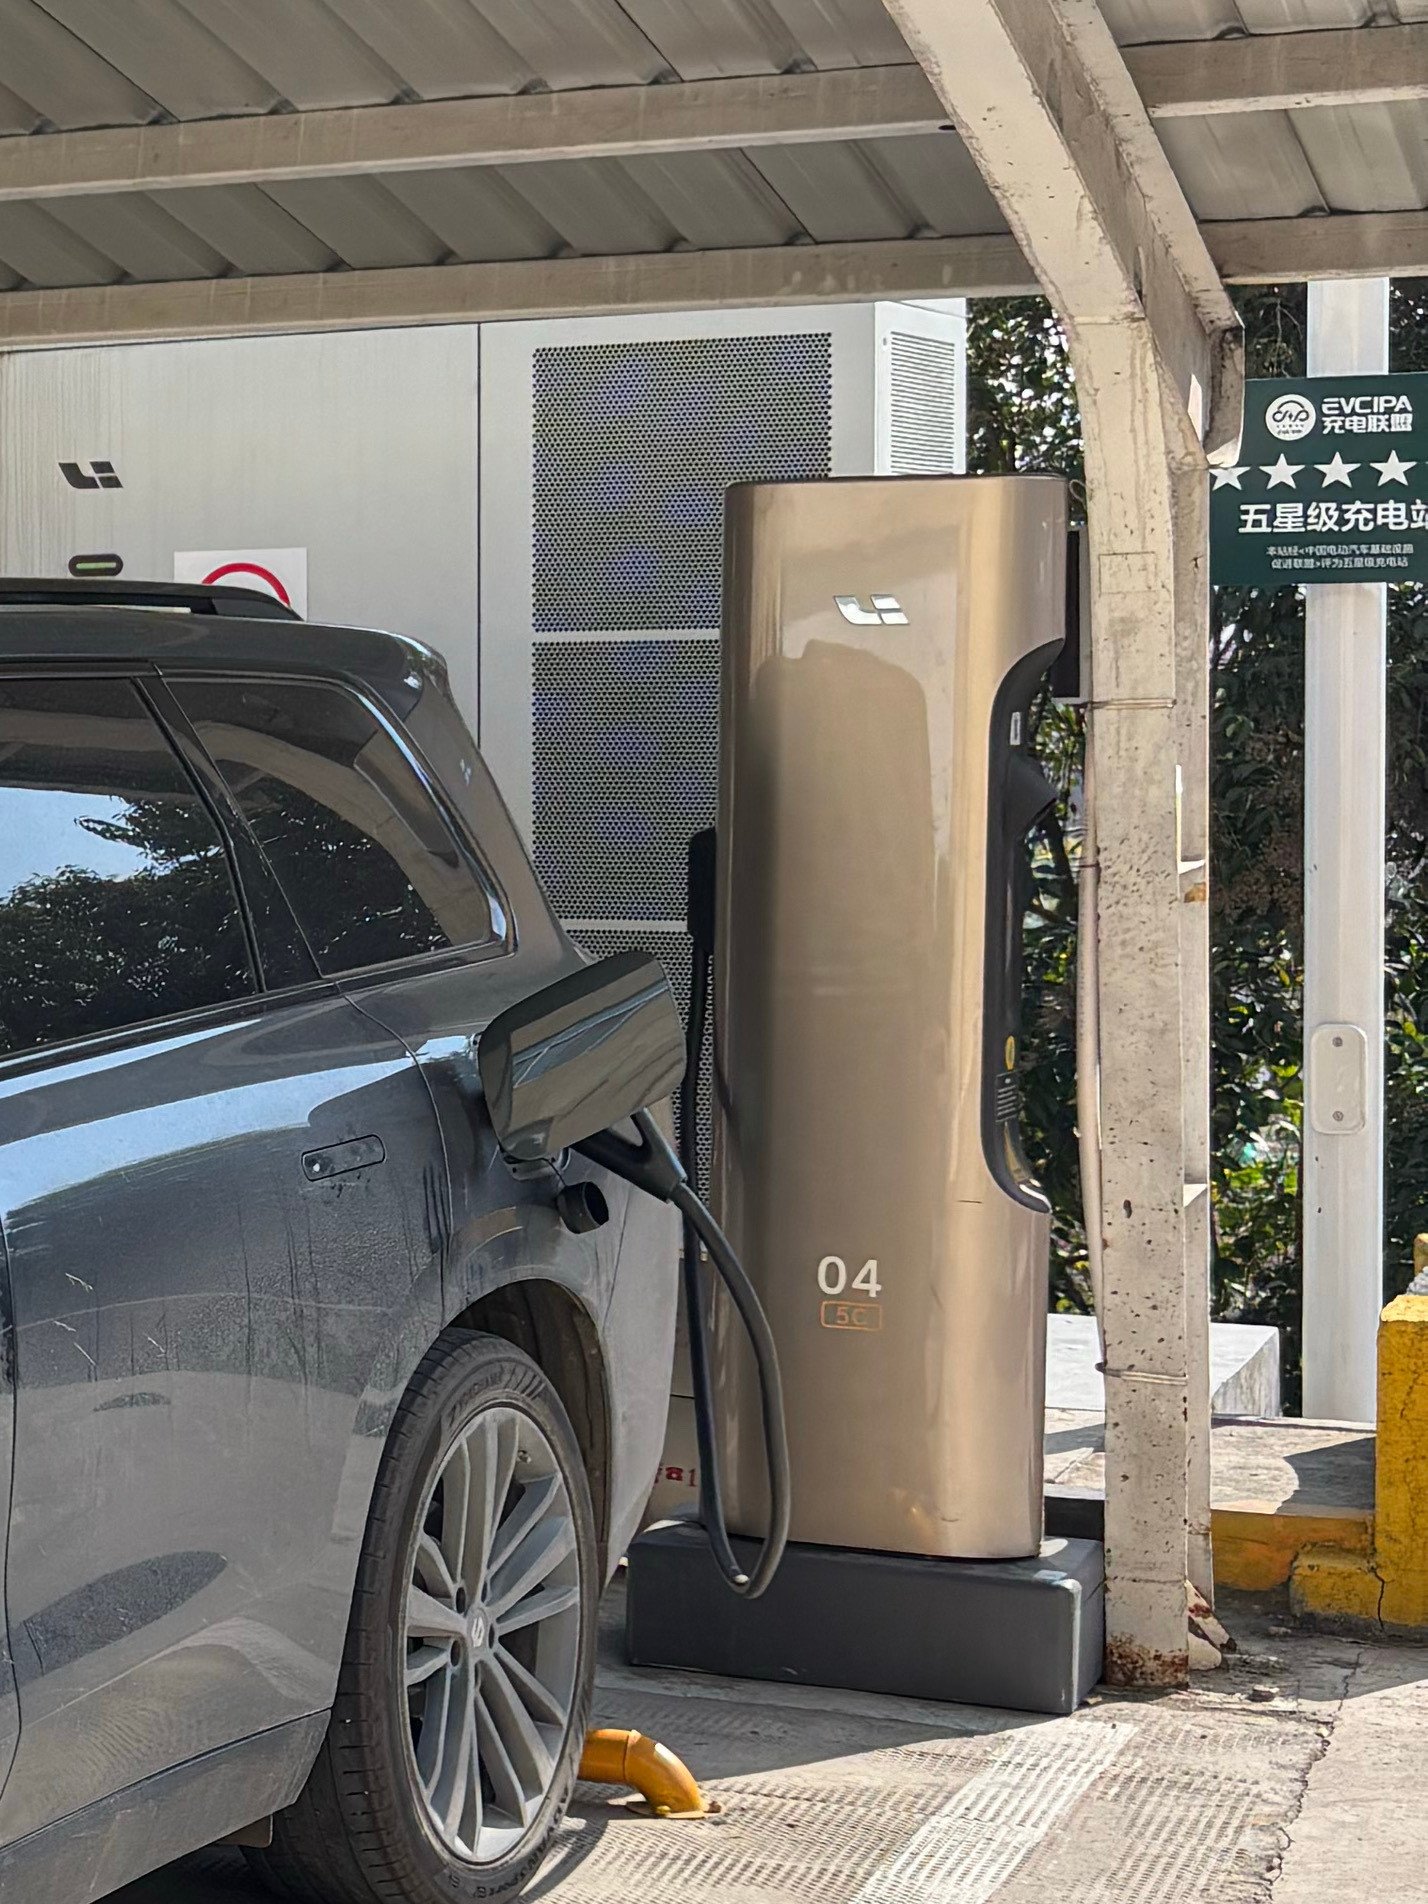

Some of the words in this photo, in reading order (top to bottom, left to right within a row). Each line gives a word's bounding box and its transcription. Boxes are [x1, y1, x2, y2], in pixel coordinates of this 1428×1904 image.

[1321, 395, 1413, 413] EVCIPA
[1322, 414, 1413, 434] 充电联盟
[817, 1255, 883, 1298] 04
